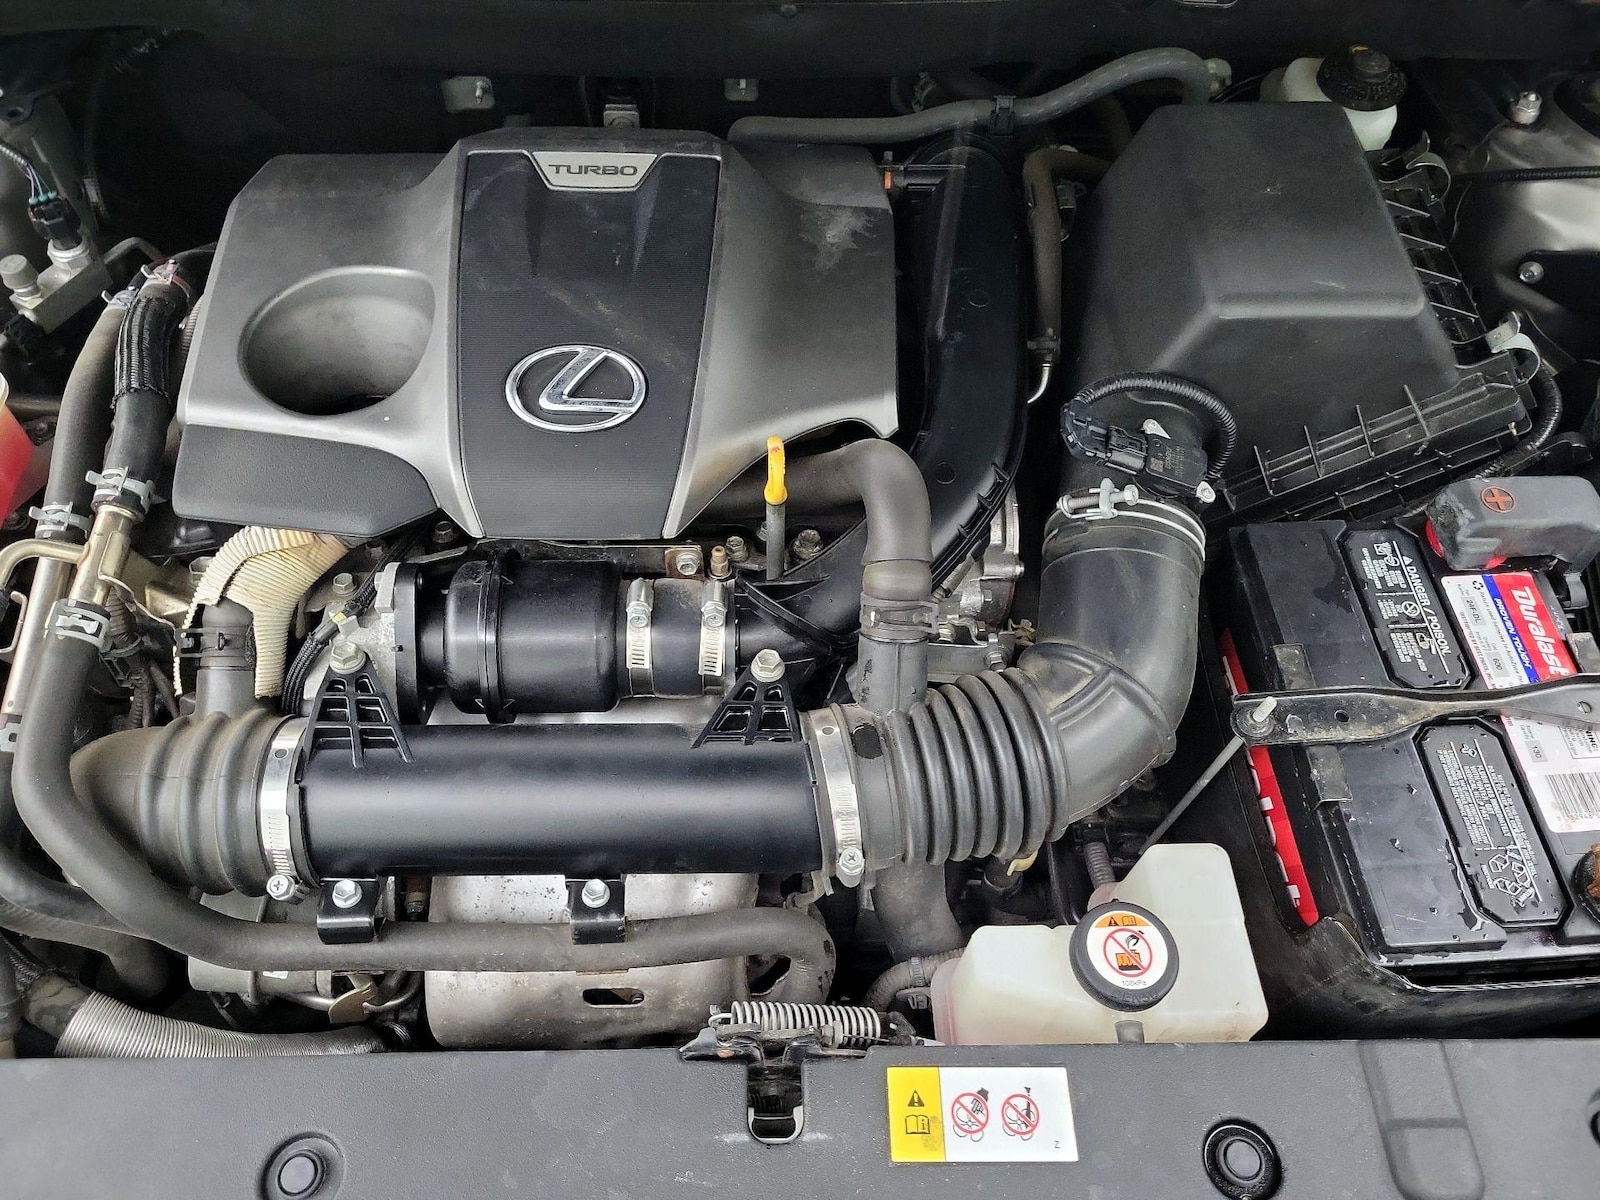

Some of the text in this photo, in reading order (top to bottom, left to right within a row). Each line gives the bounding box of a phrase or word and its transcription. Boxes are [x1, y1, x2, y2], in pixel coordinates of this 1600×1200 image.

[548, 164, 638, 176] TURBO
[1406, 566, 1430, 604] DANGER
[1427, 616, 1450, 653] POISON
[1465, 600, 1481, 622] 24F-DL
[1494, 598, 1532, 668] PROVEN TOUGH
[1510, 587, 1570, 676] Duralast
[1492, 658, 1502, 669] 600
[1531, 746, 1542, 757] 130
[1470, 766, 1480, 779] WITH
[1463, 766, 1490, 820] MEDICAL HELP FAST
[1476, 766, 1511, 836] FLUSH EYES IMMEDIATELY
